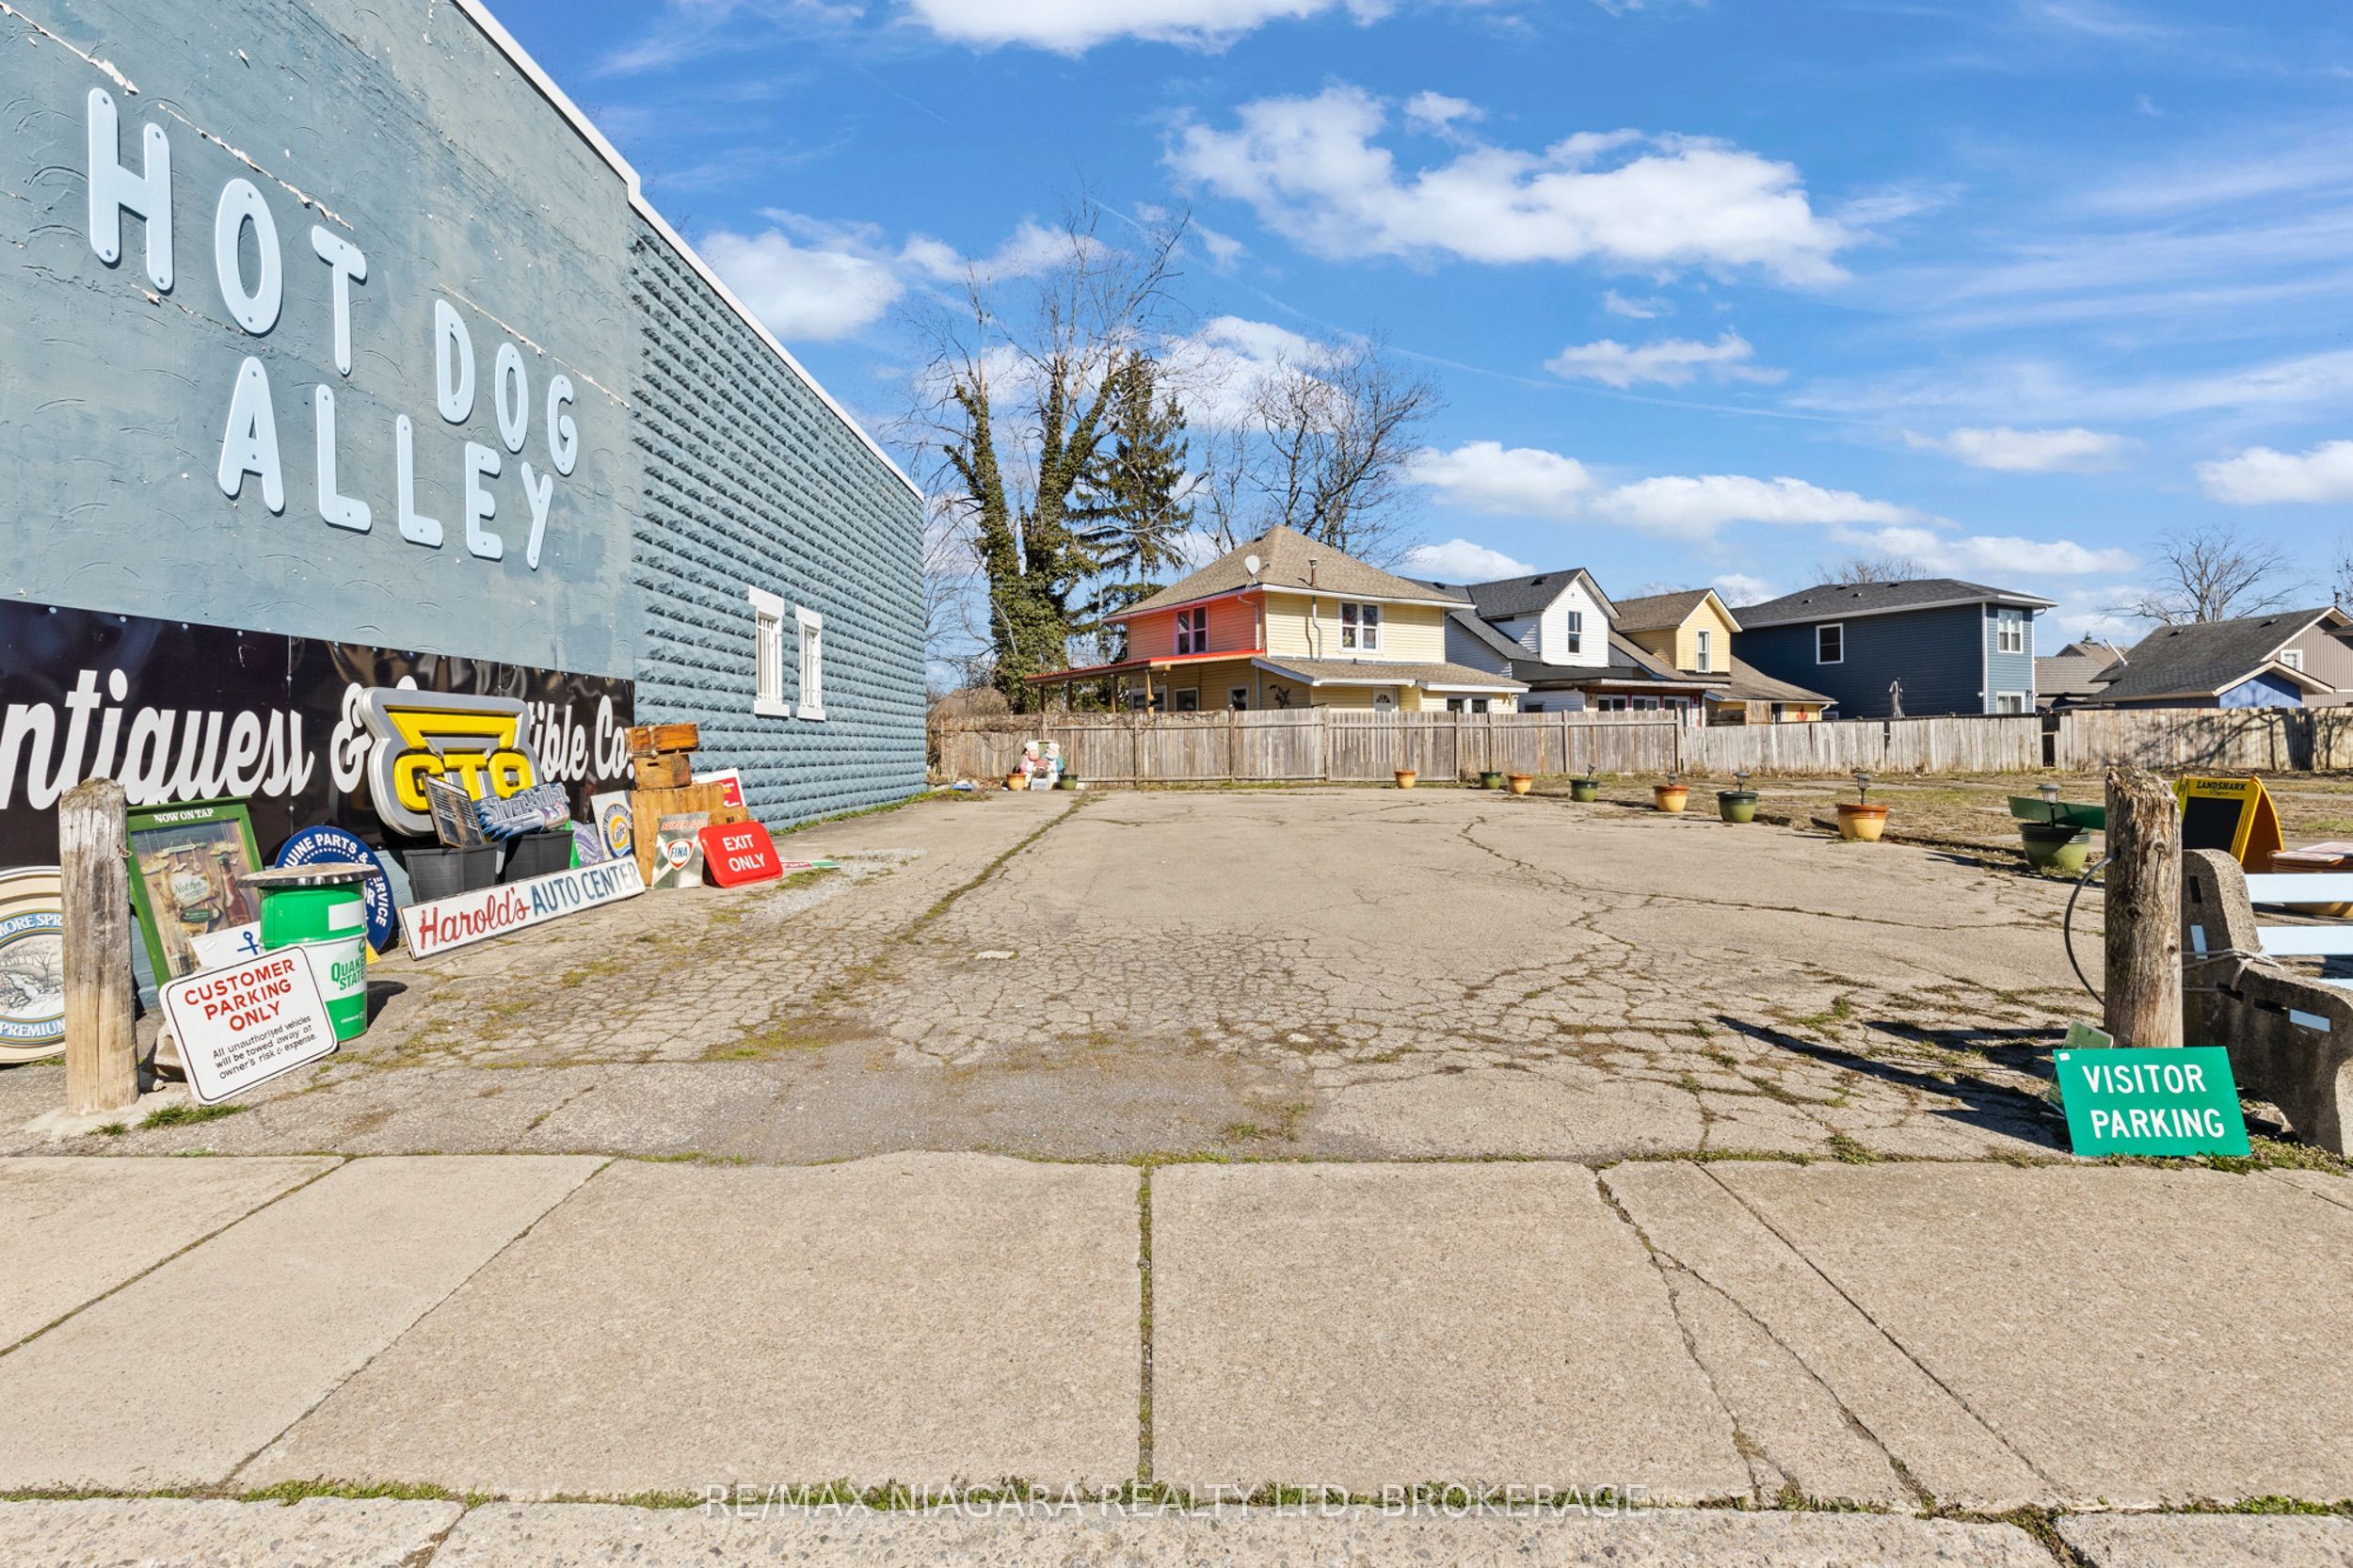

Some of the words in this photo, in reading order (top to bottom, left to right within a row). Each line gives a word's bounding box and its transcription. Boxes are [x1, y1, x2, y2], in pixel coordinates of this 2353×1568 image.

[88, 88, 368, 376] HOT
[435, 298, 578, 475] DOG
[217, 356, 553, 569] ALLEY
[393, 752, 533, 811] GTO
[2196, 780, 2247, 791] LANDSHARK
[153, 812, 179, 823] NOW
[181, 809, 194, 821] ON
[194, 808, 215, 819] TAP
[670, 846, 688, 858] FINA
[723, 834, 754, 852] EXIT
[728, 854, 766, 872] ONLY
[314, 834, 358, 855] PARTS
[359, 852, 369, 864] &
[373, 876, 389, 928] ERVICE
[36, 914, 62, 927] SPR
[419, 887, 531, 950] Harold's
[531, 875, 580, 917] AUTO
[582, 861, 641, 900] CENTER
[184, 959, 296, 1005] CUSTOMER
[331, 955, 364, 982] QUAKE
[339, 968, 364, 991] STATE
[203, 979, 292, 1020] PARKING
[229, 1000, 280, 1032] ONLY
[213, 1049, 225, 1060] All
[286, 1016, 312, 1031] vehicles
[216, 1055, 232, 1069] will
[233, 1051, 245, 1062] be
[247, 1041, 274, 1057] towed
[277, 1030, 299, 1045] away
[303, 1025, 312, 1034] at
[219, 1059, 256, 1080] owner's
[259, 1050, 275, 1063] risk
[2082, 1064, 2207, 1094] VISITOR
[2090, 1108, 2225, 1139] PARKING
